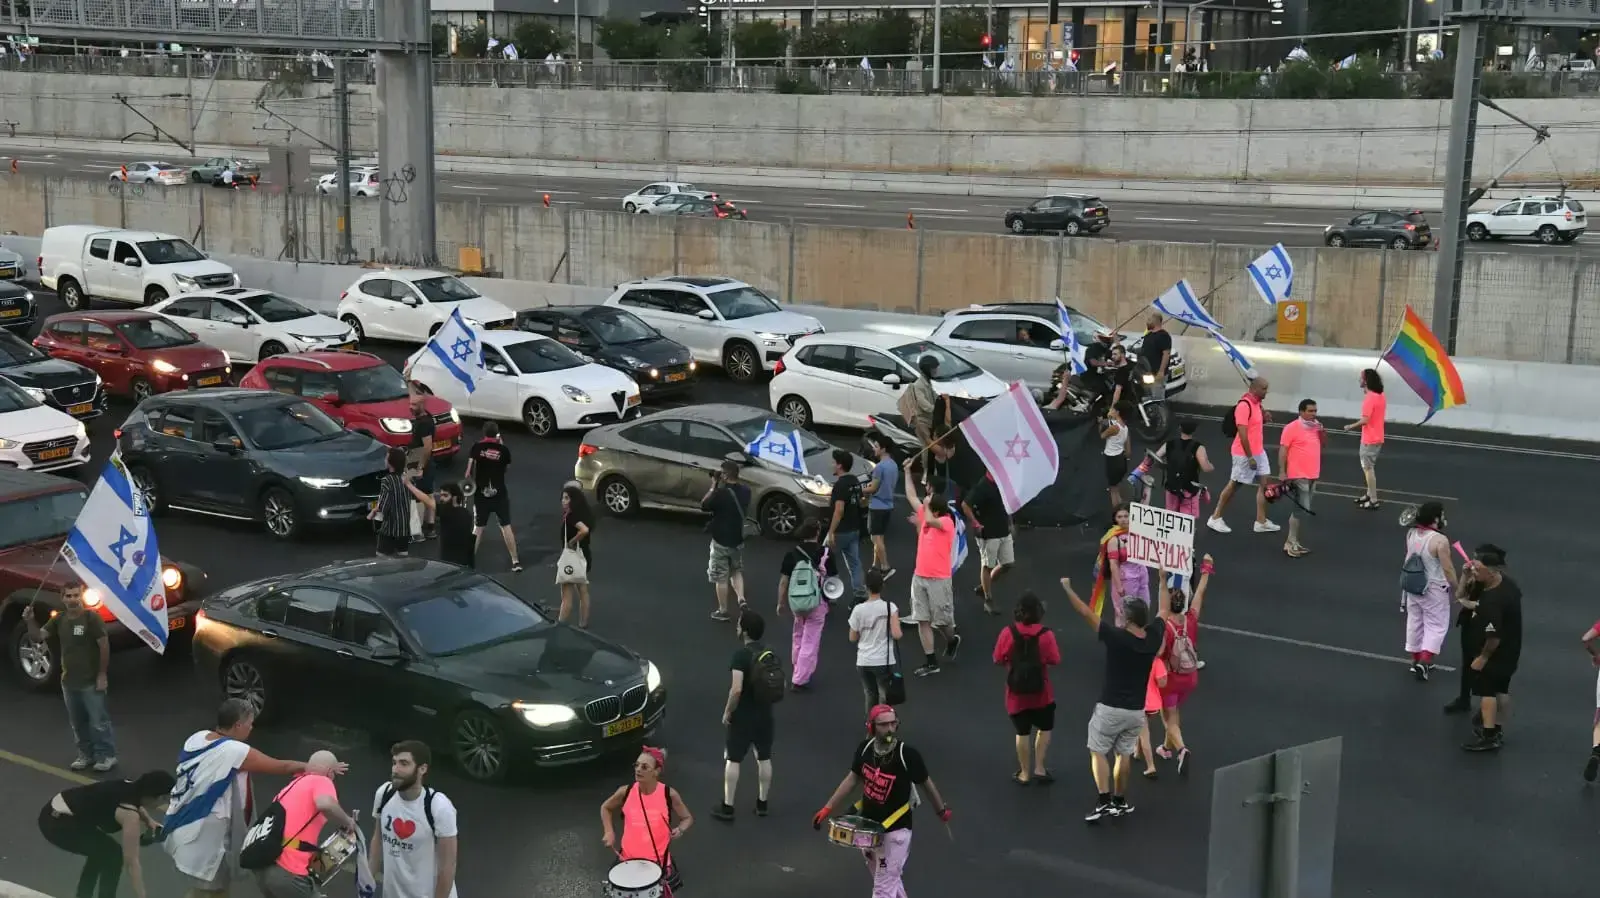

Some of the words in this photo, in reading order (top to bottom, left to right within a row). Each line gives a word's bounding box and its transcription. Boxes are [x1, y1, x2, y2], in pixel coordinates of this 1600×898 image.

[1132, 504, 1193, 534] הרפורמה
[1156, 528, 1170, 539] זה
[384, 814, 392, 831] I
